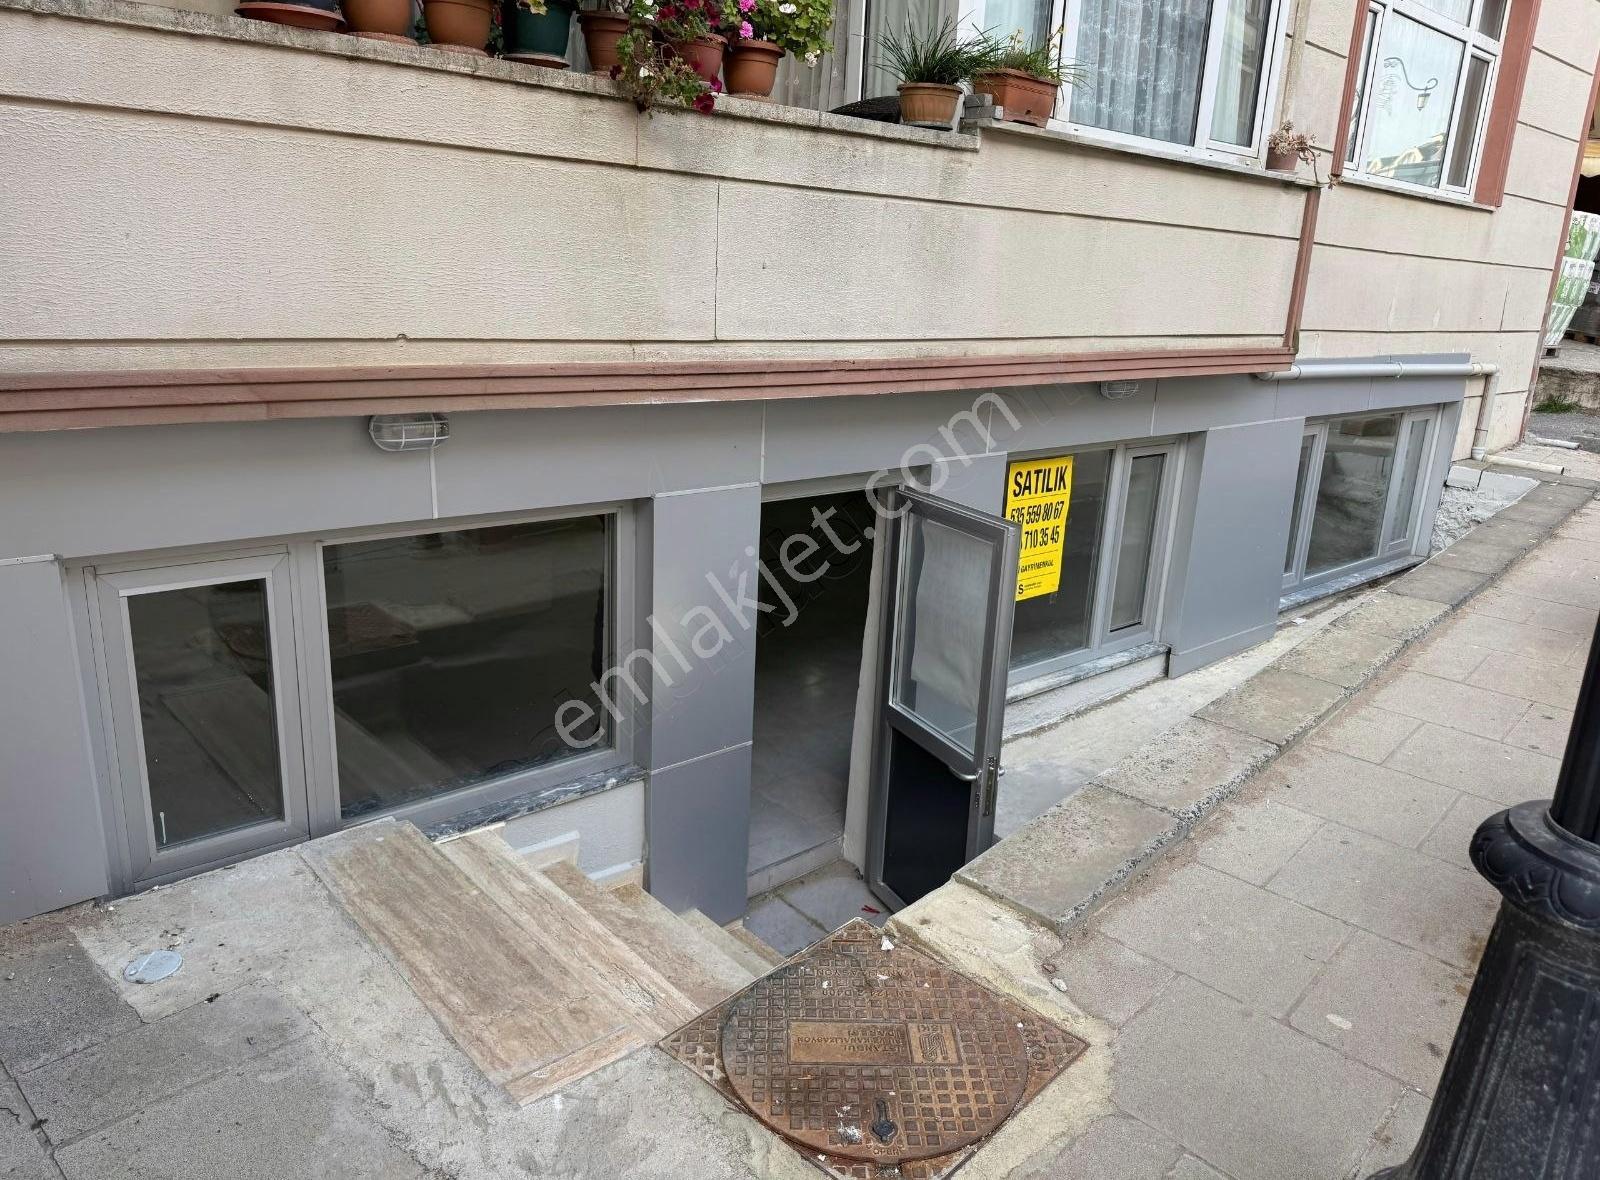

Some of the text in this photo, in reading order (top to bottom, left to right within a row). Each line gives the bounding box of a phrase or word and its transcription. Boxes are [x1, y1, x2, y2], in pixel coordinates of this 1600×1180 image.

[1013, 465, 1068, 497] SATILIK
[1025, 504, 1041, 524] 559
[1041, 502, 1054, 522] 80
[1053, 501, 1065, 520] 67
[1024, 529, 1038, 551] 710
[1039, 527, 1049, 547] 35
[1050, 525, 1060, 545] 45
